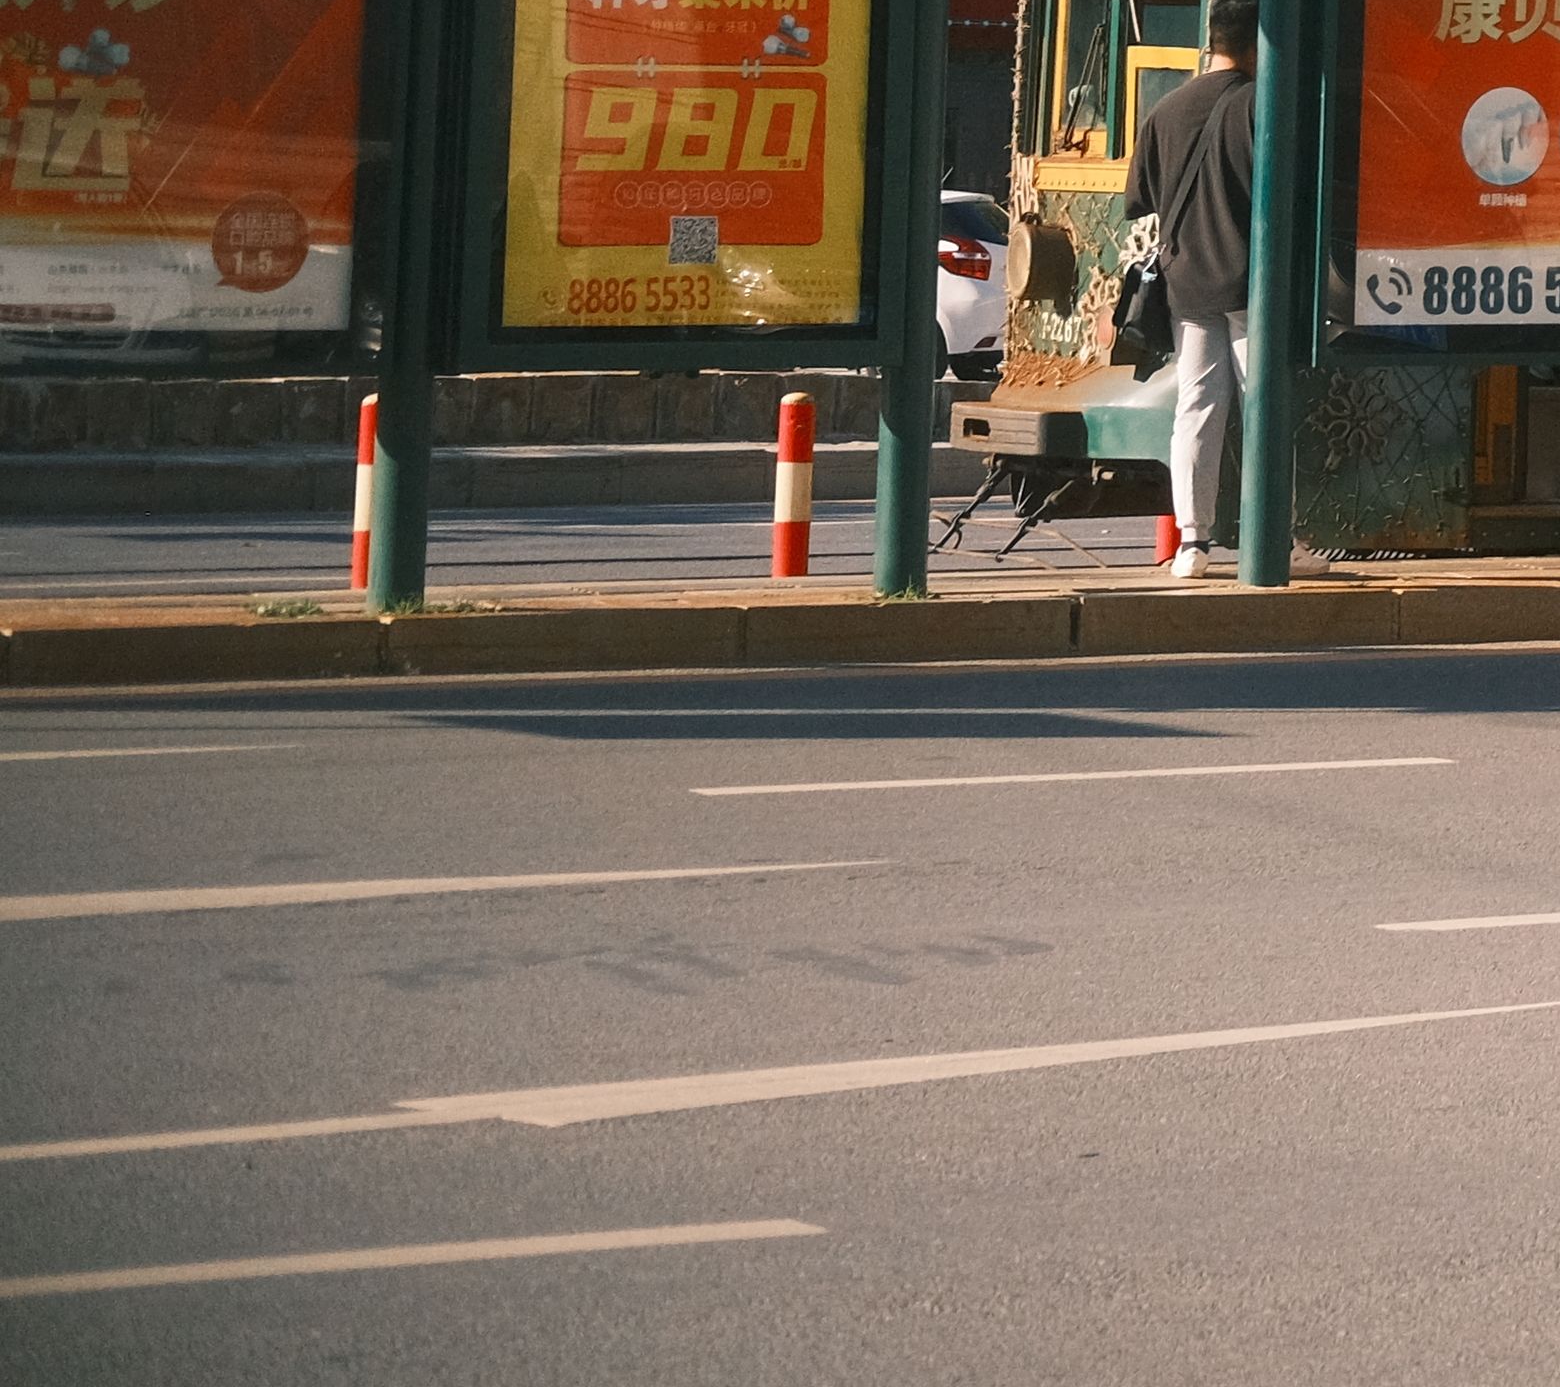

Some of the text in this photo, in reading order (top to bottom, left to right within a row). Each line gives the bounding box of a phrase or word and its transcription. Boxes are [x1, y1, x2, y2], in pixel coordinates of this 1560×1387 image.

[575, 87, 818, 171] 980
[567, 278, 637, 316] 8886
[645, 275, 711, 312] 5533
[1423, 265, 1533, 316] 8886
